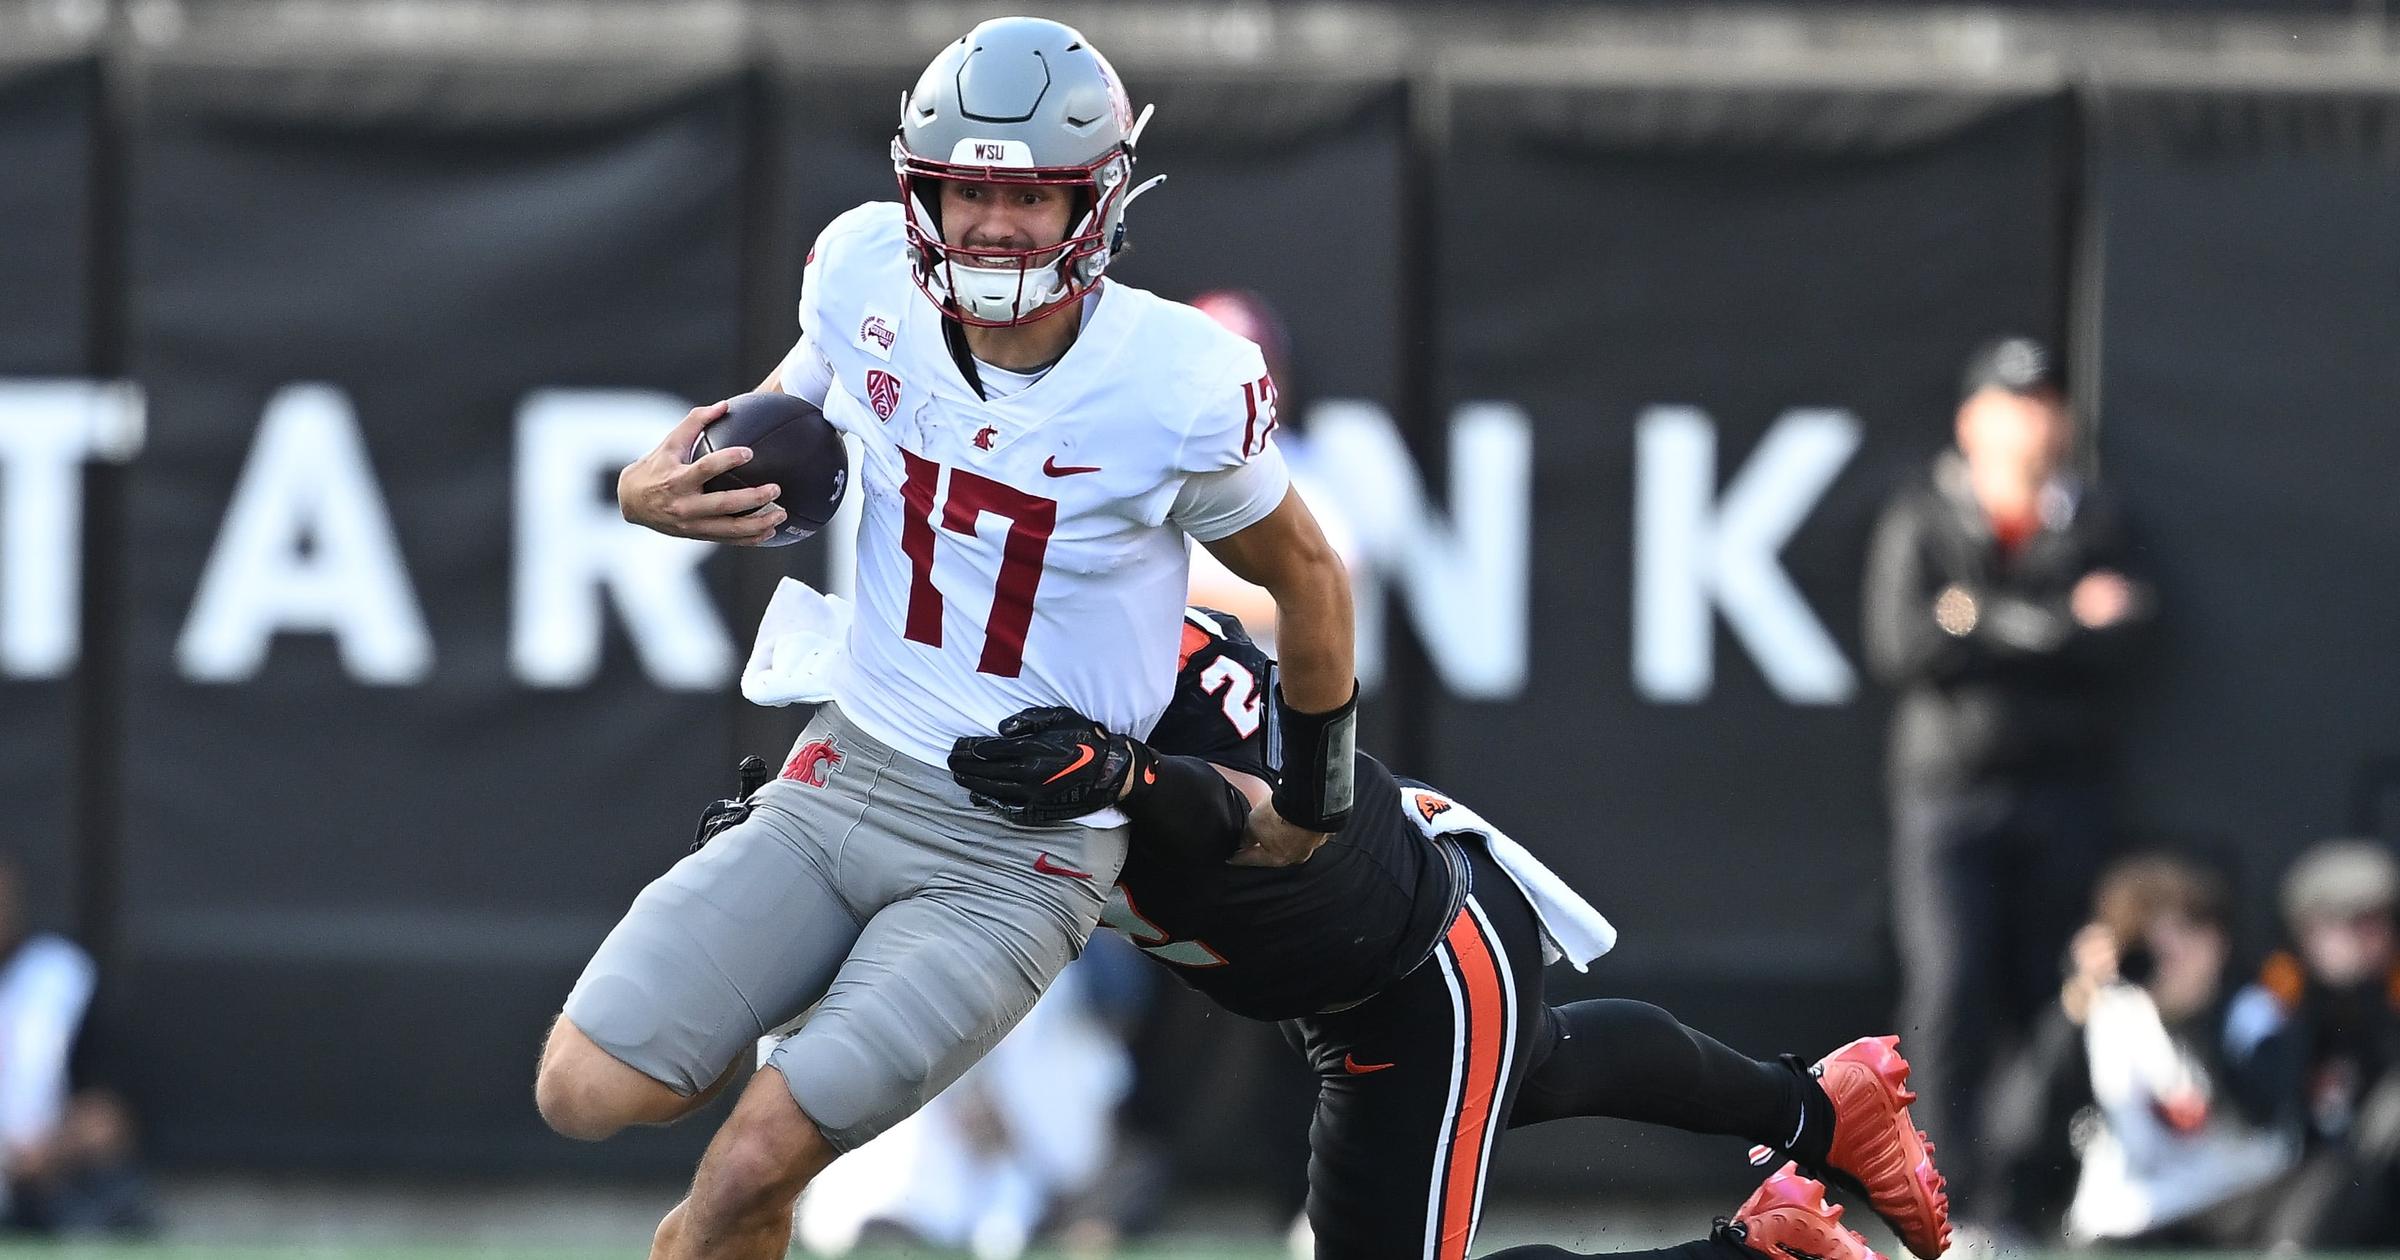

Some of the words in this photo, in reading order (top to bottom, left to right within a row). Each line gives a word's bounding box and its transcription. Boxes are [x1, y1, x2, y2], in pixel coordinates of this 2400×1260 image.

[974, 142, 1005, 160] WSU
[896, 444, 1057, 678] 17
[1200, 654, 1260, 740] 2
